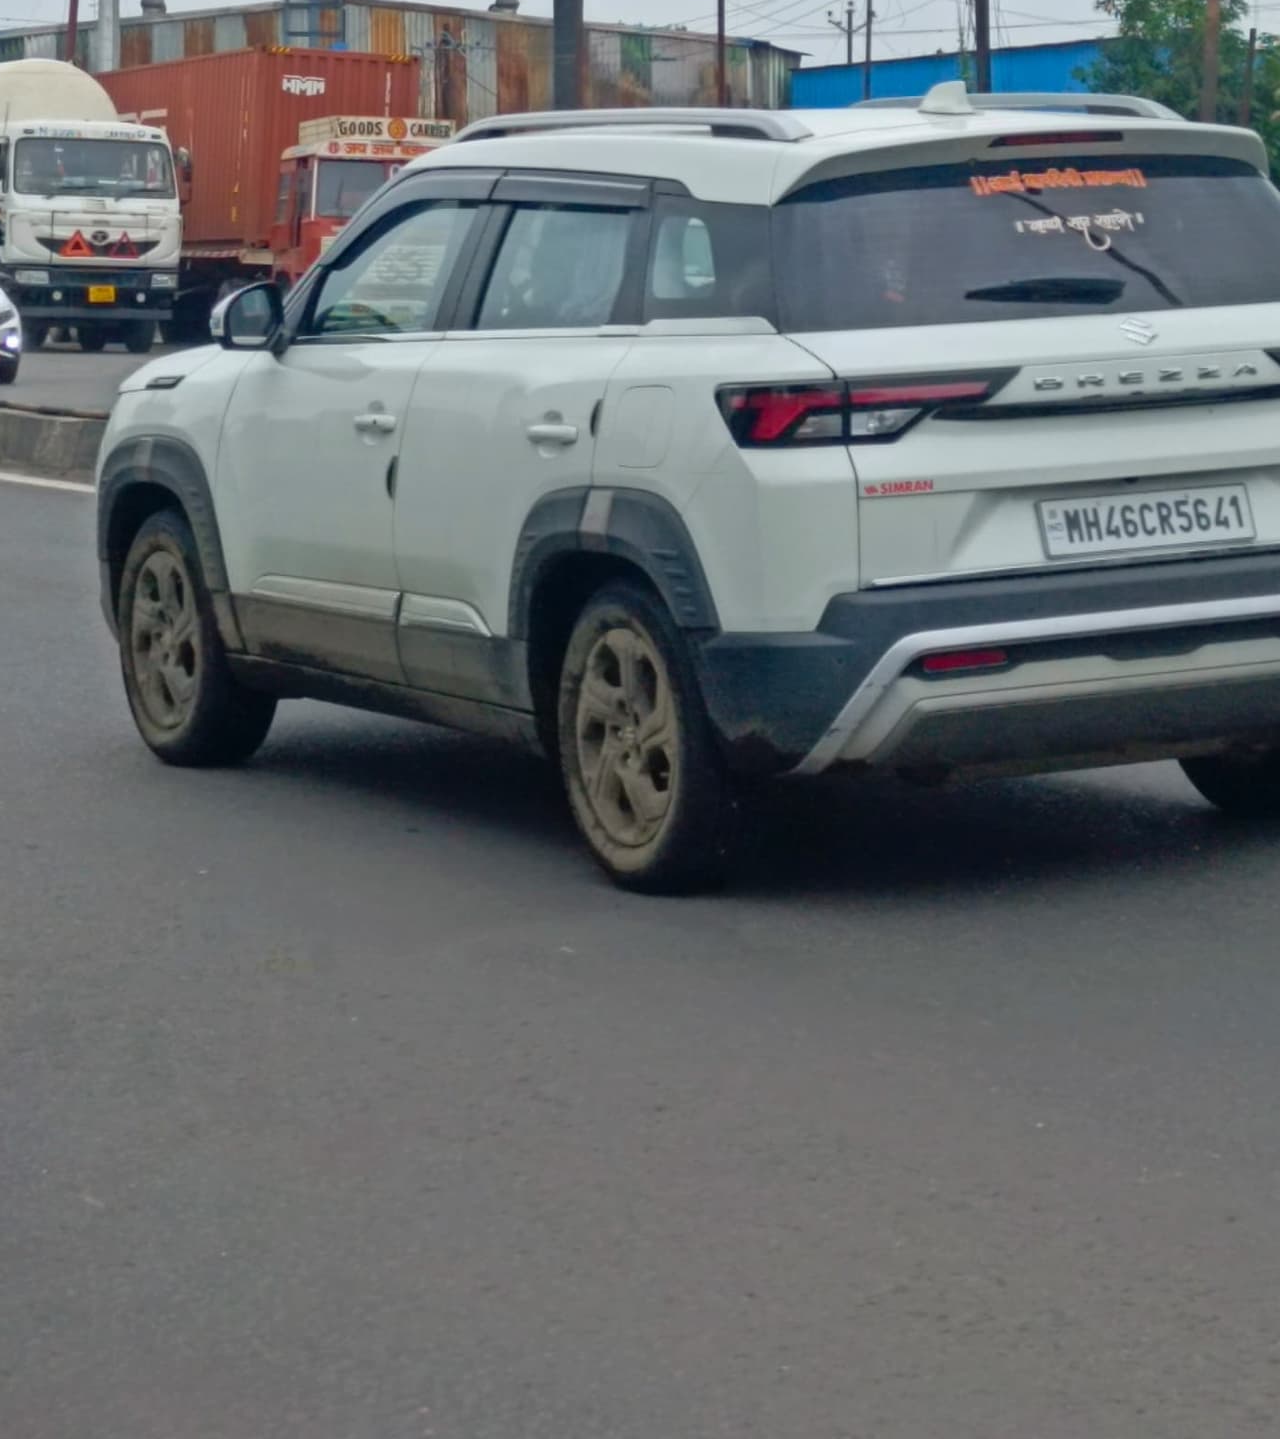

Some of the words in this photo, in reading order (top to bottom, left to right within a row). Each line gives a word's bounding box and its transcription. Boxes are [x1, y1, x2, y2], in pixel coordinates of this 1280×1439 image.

[282, 74, 326, 97] HMM
[338, 120, 384, 137] GOODS
[410, 122, 451, 137] CARRIER
[1033, 364, 1257, 391] BREZZA
[880, 479, 934, 495] SIMRAN
[1063, 494, 1245, 544] MH46CR5641
